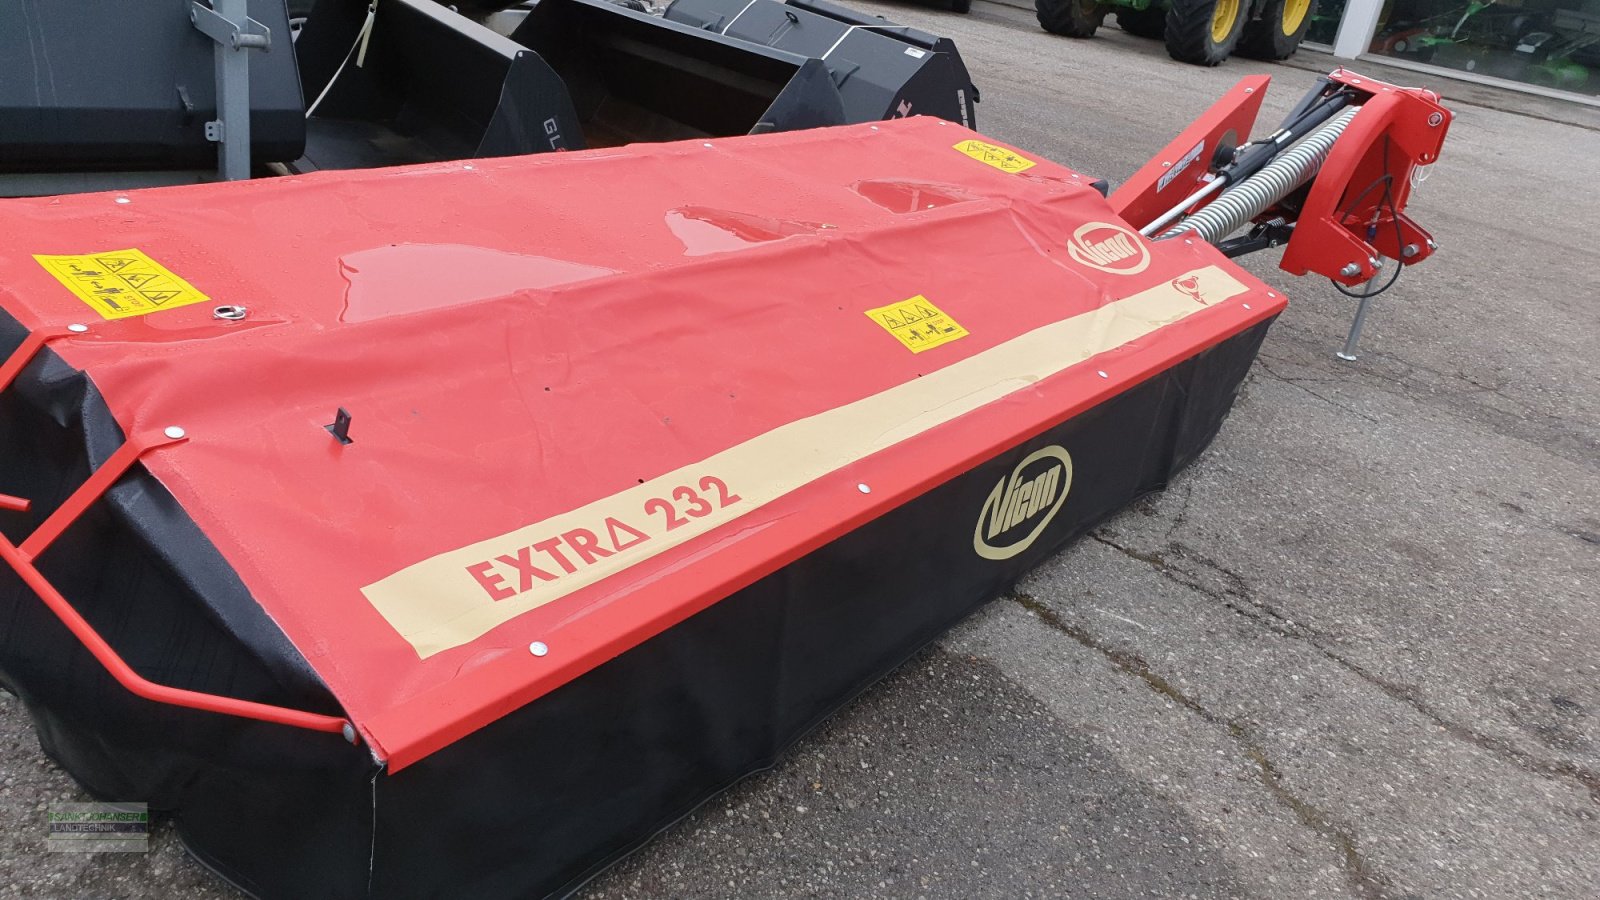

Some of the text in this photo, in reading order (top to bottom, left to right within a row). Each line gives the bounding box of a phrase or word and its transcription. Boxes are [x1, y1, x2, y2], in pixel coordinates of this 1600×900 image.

[1067, 229, 1139, 267] Vicon
[464, 475, 743, 602] EXTRA 232
[985, 463, 1062, 541] Vicon
